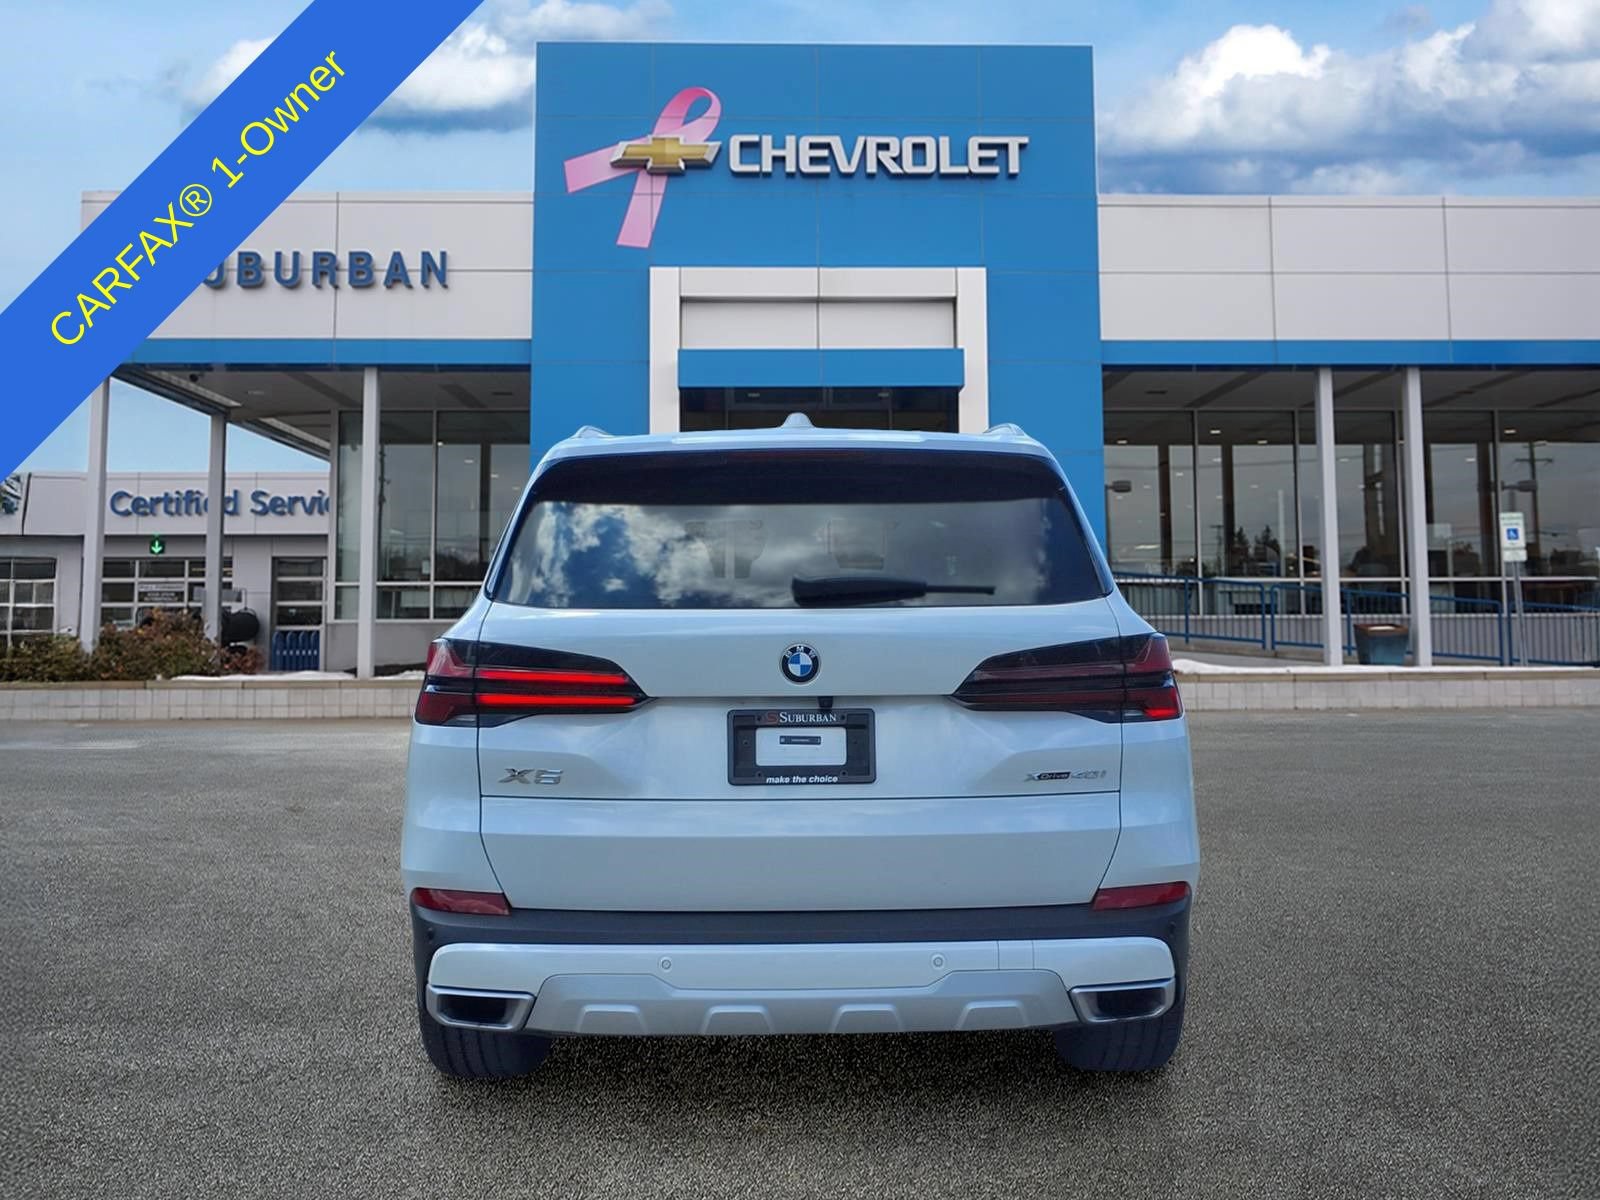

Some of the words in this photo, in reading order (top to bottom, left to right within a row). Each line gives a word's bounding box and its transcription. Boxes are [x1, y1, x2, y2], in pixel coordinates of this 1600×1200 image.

[729, 135, 1030, 176] CHEVROLET
[203, 251, 449, 288] UBURBAN
[110, 490, 240, 516] Certifid
[250, 489, 330, 516] Servi
[766, 776, 790, 784] make
[792, 775, 807, 783] the
[808, 775, 839, 783] choice
